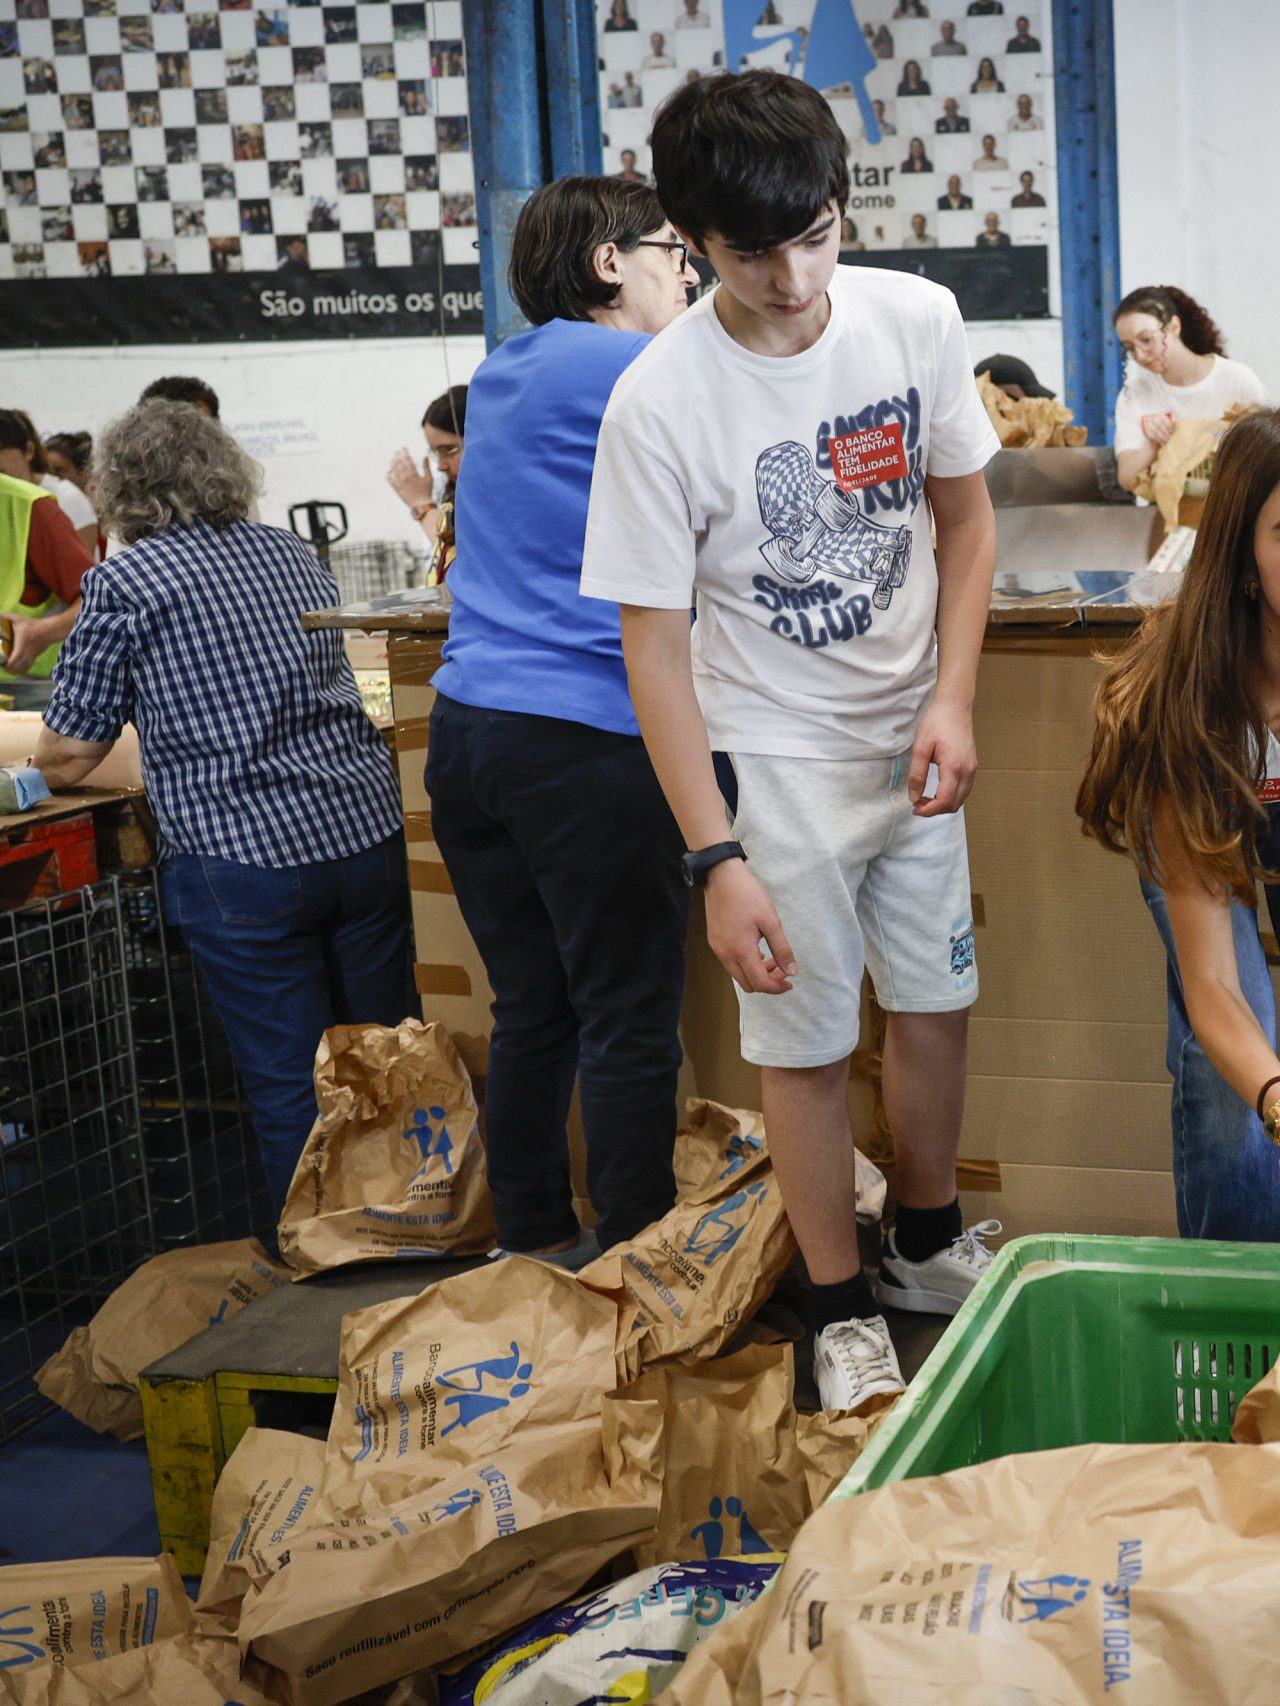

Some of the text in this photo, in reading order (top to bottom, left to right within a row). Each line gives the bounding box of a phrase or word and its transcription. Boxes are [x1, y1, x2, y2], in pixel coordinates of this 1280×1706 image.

[260, 289, 306, 318] São
[312, 288, 399, 315] muitos
[404, 291, 435, 313] os
[834, 430, 884, 451] O BANCO
[836, 436, 897, 460] ALIMENTAR
[838, 455, 861, 469] TEM
[839, 454, 900, 479] FIDELIDADE
[751, 573, 844, 613] SKATE
[769, 592, 873, 649] CLUB
[390, 1350, 404, 1402] ALIMENTE
[414, 1384, 428, 1416] contra
[422, 1343, 441, 1447] Bancoalimentar
[395, 1400, 410, 1428] ESTA
[62, 1621, 74, 1654] contra
[91, 1618, 106, 1649] ESTA
[305, 1655, 336, 1679] Saco
[414, 1616, 441, 1634] com
[1103, 1628, 1131, 1693] IDEIA.
